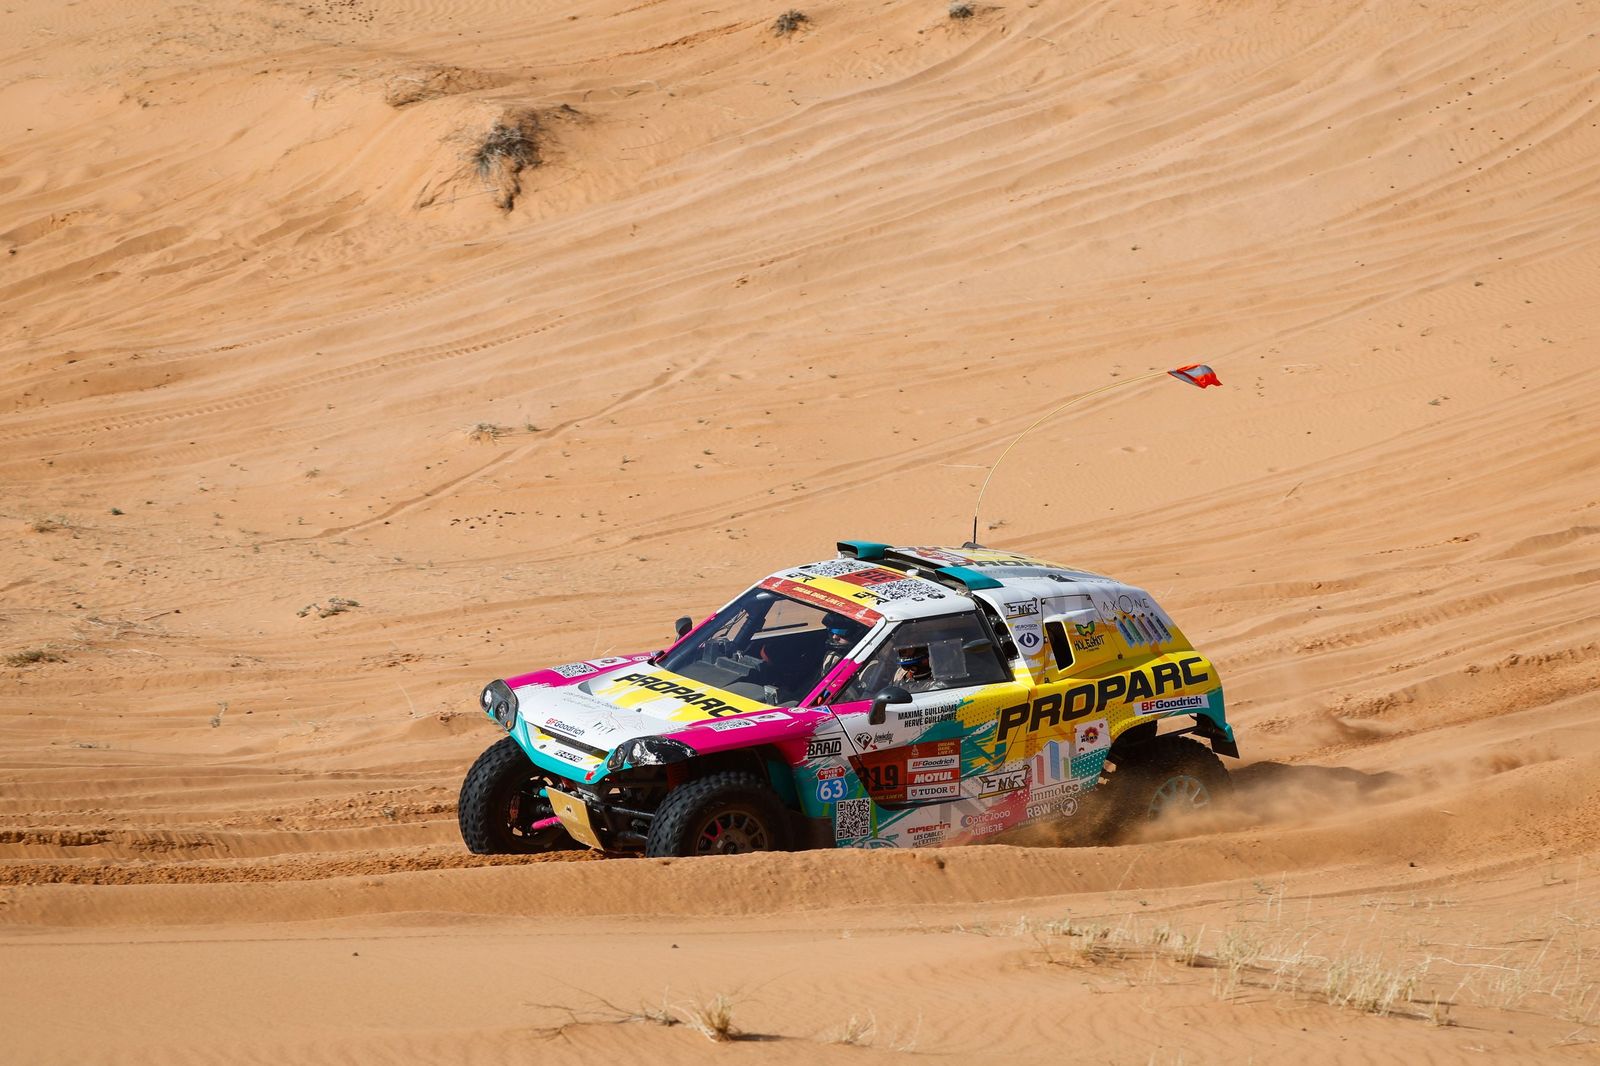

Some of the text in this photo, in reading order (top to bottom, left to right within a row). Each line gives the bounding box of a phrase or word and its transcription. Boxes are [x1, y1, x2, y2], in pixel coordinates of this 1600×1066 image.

[613, 672, 743, 718] PROPARC
[997, 657, 1208, 740] PROPARC
[1141, 695, 1202, 711] BFGoodrich
[898, 709, 923, 720] MAXIME
[545, 717, 585, 738] BFGoodrich
[808, 740, 842, 756] BRAID
[912, 757, 955, 768] BFGoodrich
[914, 771, 953, 784] MOTUL
[820, 779, 844, 801] 63
[918, 787, 948, 795] TUDOR
[1029, 782, 1080, 802] immolec
[1026, 802, 1051, 819] RBW
[907, 821, 951, 834] omerin
[914, 832, 924, 840] LES
